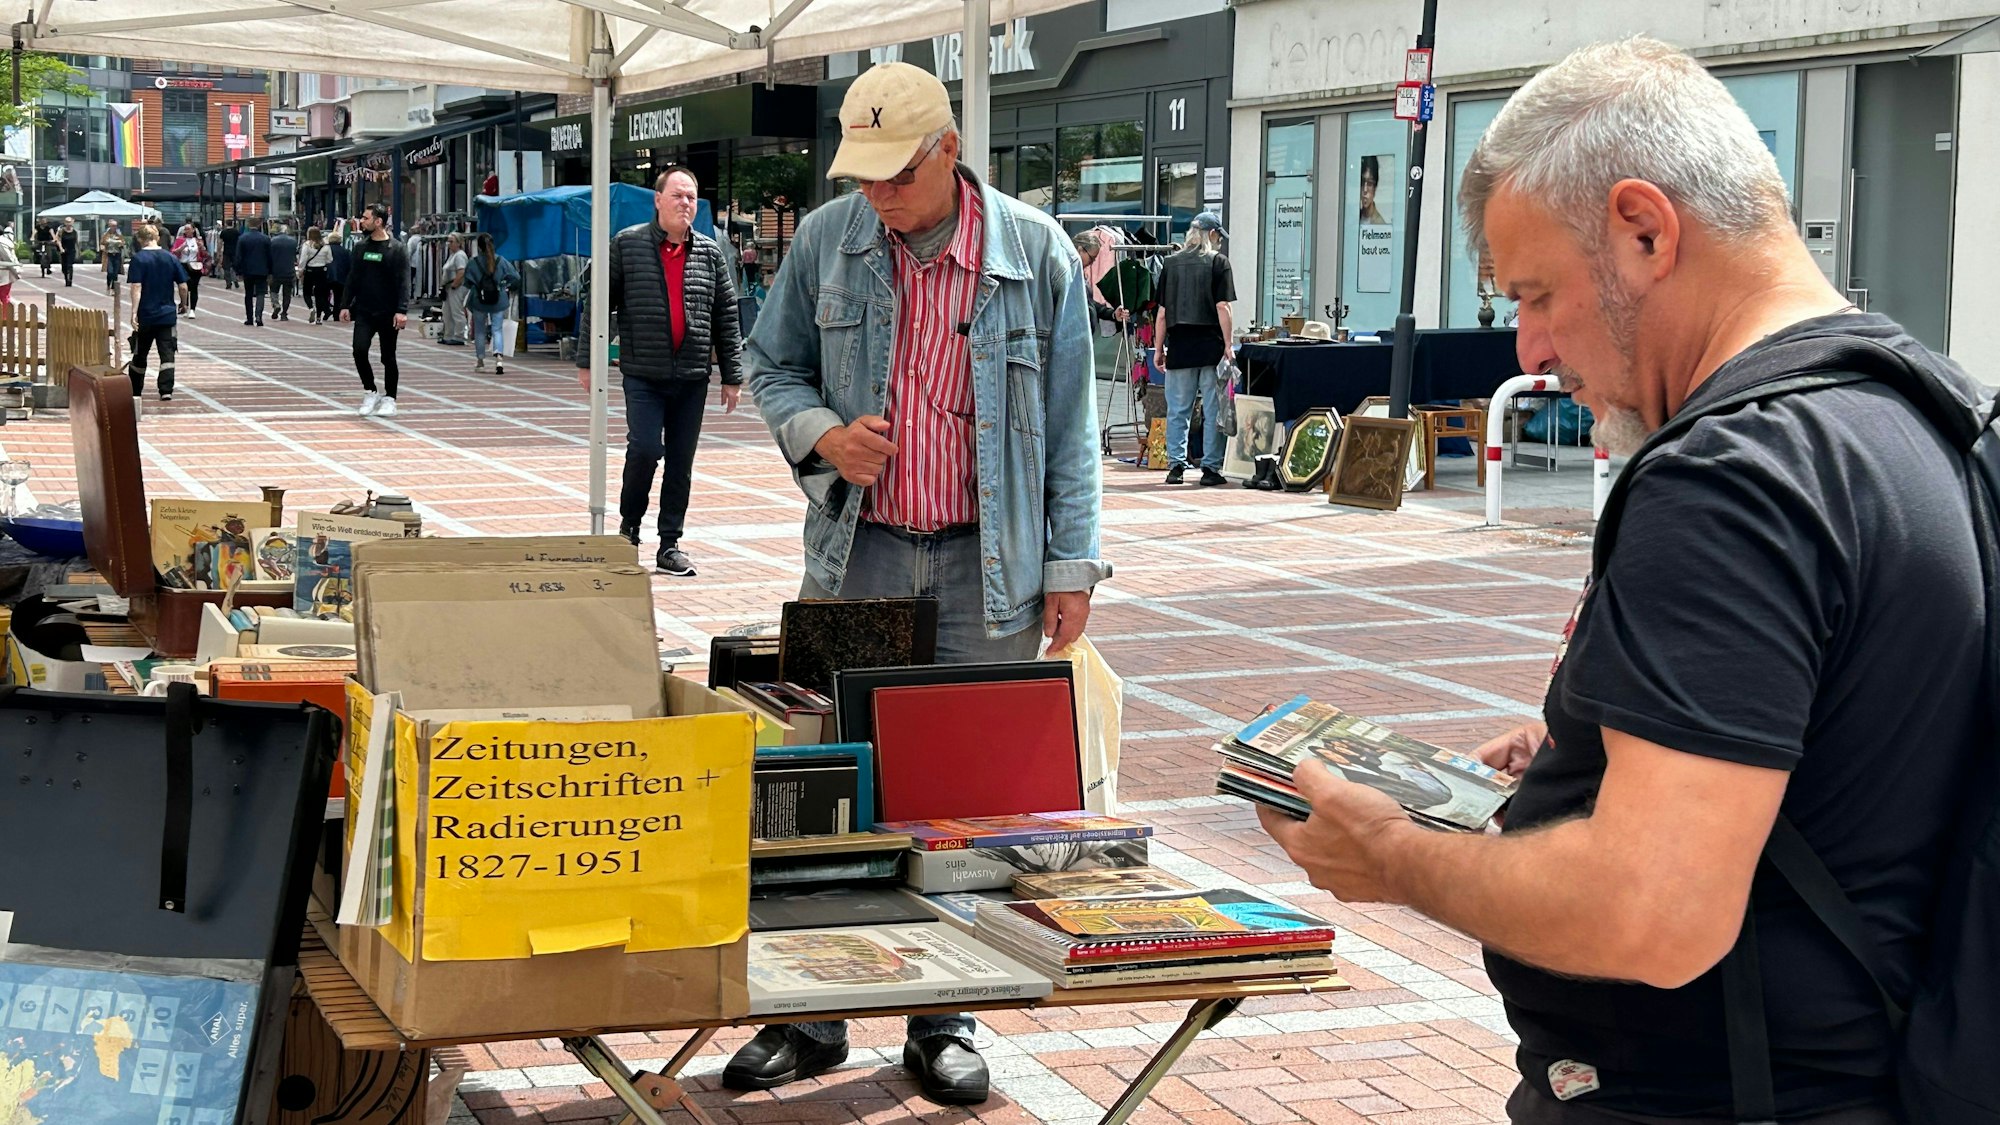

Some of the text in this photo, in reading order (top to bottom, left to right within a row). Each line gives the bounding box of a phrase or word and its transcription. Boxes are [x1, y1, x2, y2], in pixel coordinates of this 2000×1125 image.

[274, 116, 306, 126] TLS
[628, 106, 683, 142] LEVERKUSEN
[1169, 98, 1185, 131] 11
[405, 136, 443, 164] Trendy
[1362, 228, 1391, 240] Fielmann
[1361, 244, 1378, 255] baut
[337, 526, 352, 534] Welt
[433, 736, 648, 766] Zeitungen,
[432, 768, 720, 800] Zeitschriften +
[431, 812, 683, 841] Radierungen
[934, 839, 963, 850] TOPP
[435, 849, 644, 880] 1827-1951
[945, 859, 967, 870] eins
[952, 868, 998, 883] Auswahl
[52, 1003, 69, 1016] 7
[119, 1009, 137, 1023] 9
[151, 1006, 172, 1030] 10
[209, 1015, 222, 1041] ARAL
[227, 1001, 249, 1059] Alles super.
[139, 1061, 160, 1081] 11
[175, 1063, 194, 1084] 12
